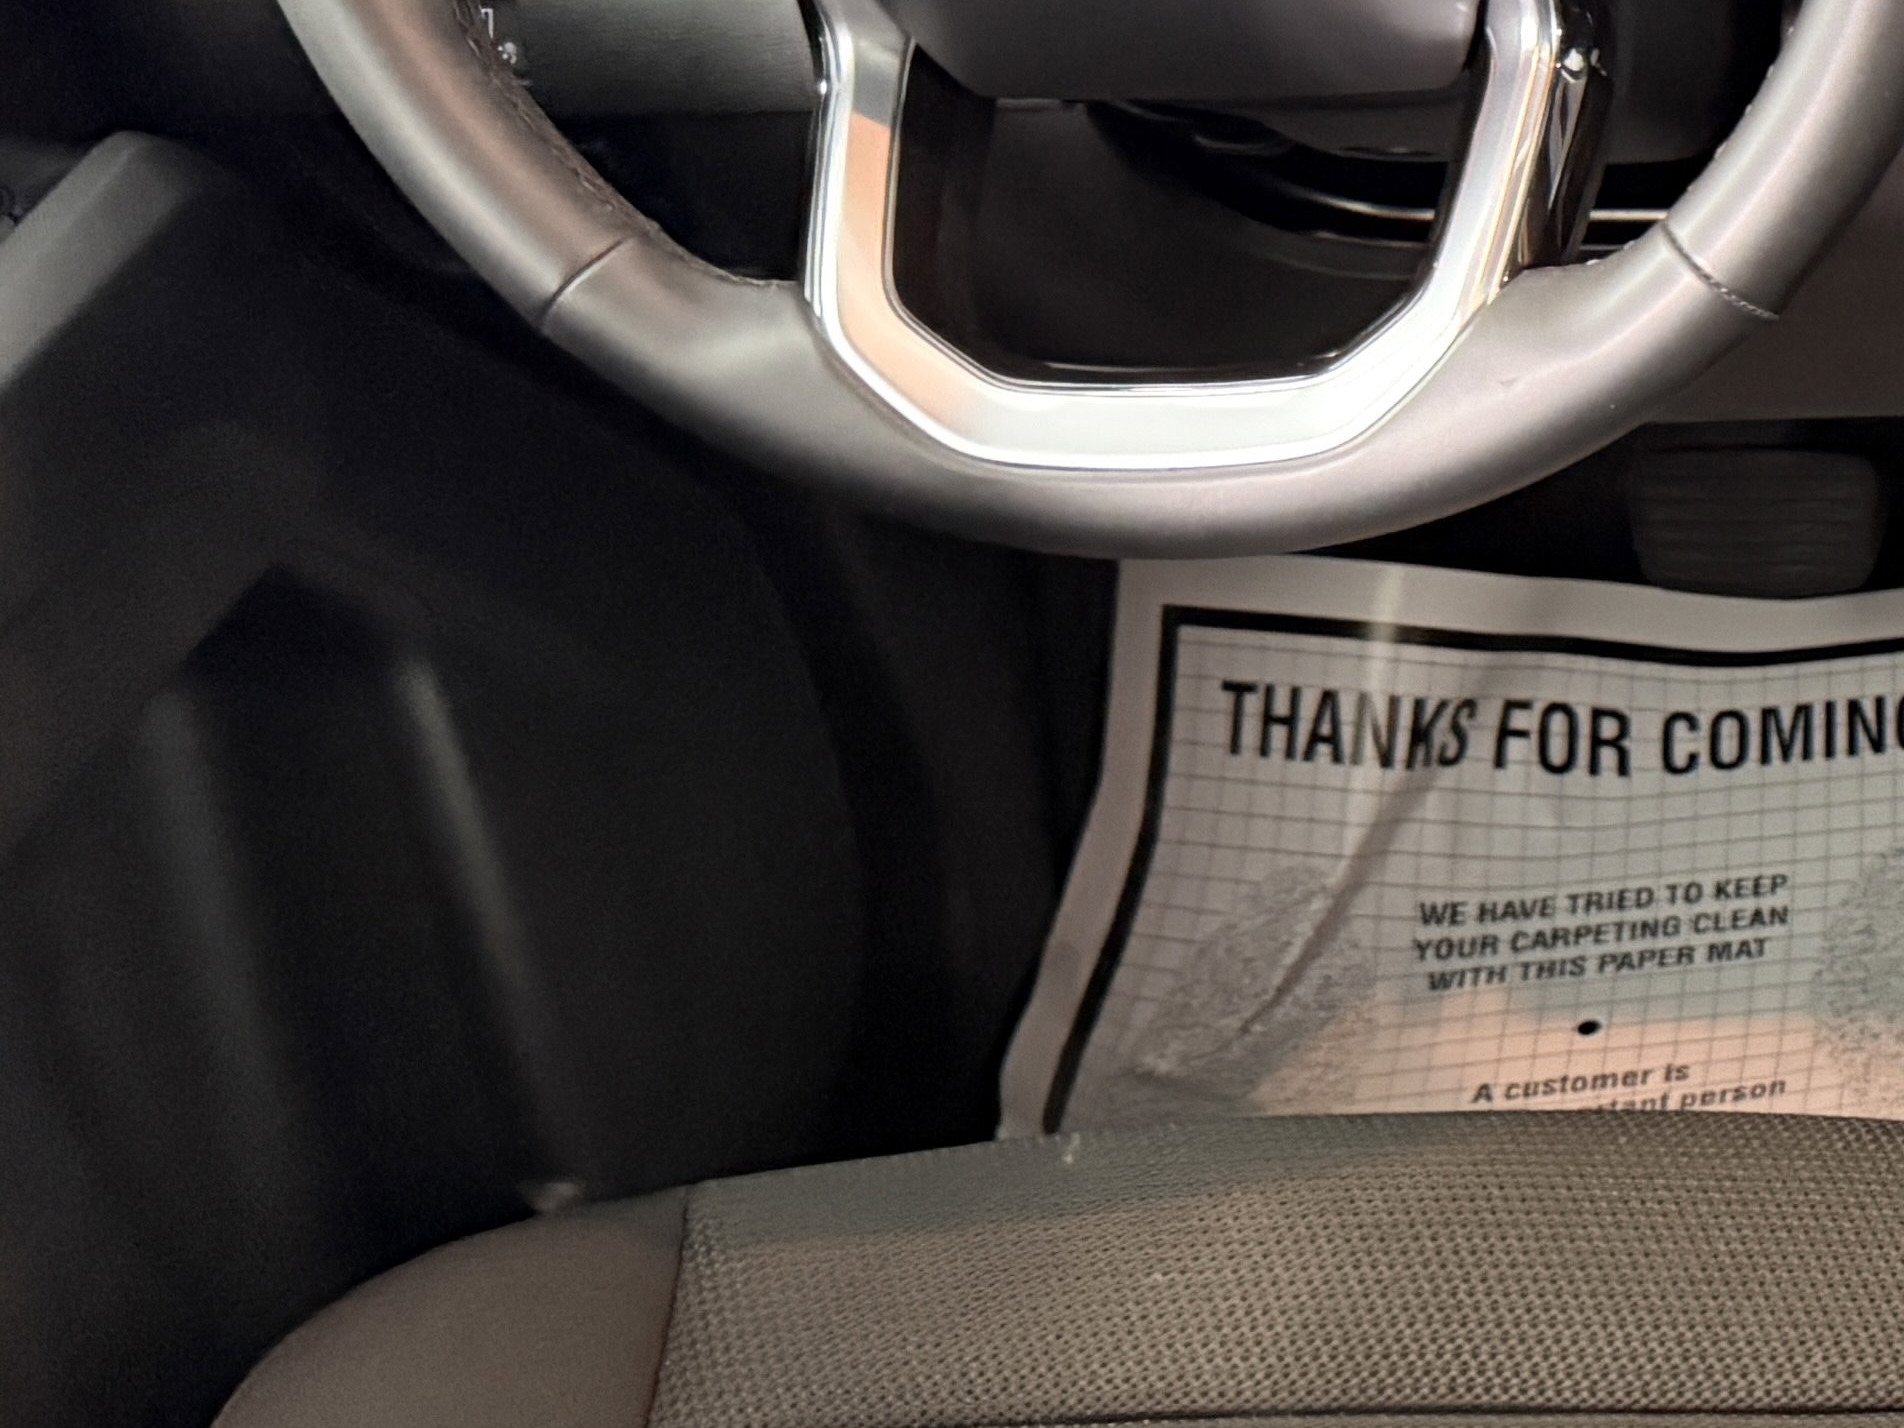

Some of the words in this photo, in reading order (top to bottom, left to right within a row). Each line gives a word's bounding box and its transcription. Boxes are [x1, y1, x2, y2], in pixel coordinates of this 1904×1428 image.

[1221, 679, 1478, 771] THANKS
[1494, 699, 1632, 777] FOR
[1419, 899, 1468, 928] WE
[1478, 894, 1557, 925] HAVE
[1567, 885, 1655, 916] TRIED
[1666, 880, 1703, 906] TO
[1713, 873, 1789, 902] KEEP
[1413, 934, 1499, 963] YOUR
[1509, 914, 1682, 955] CARPETING
[1692, 905, 1789, 935] CLEAN
[1427, 964, 1507, 992] WITH
[1519, 954, 1587, 983] THIS
[1597, 944, 1696, 974] PAPER
[1706, 936, 1770, 964] MAT
[1471, 1083, 1494, 1105] A
[1504, 1065, 1654, 1102] customer
[1664, 1061, 1691, 1084] is
[1679, 1078, 1787, 1112] person
